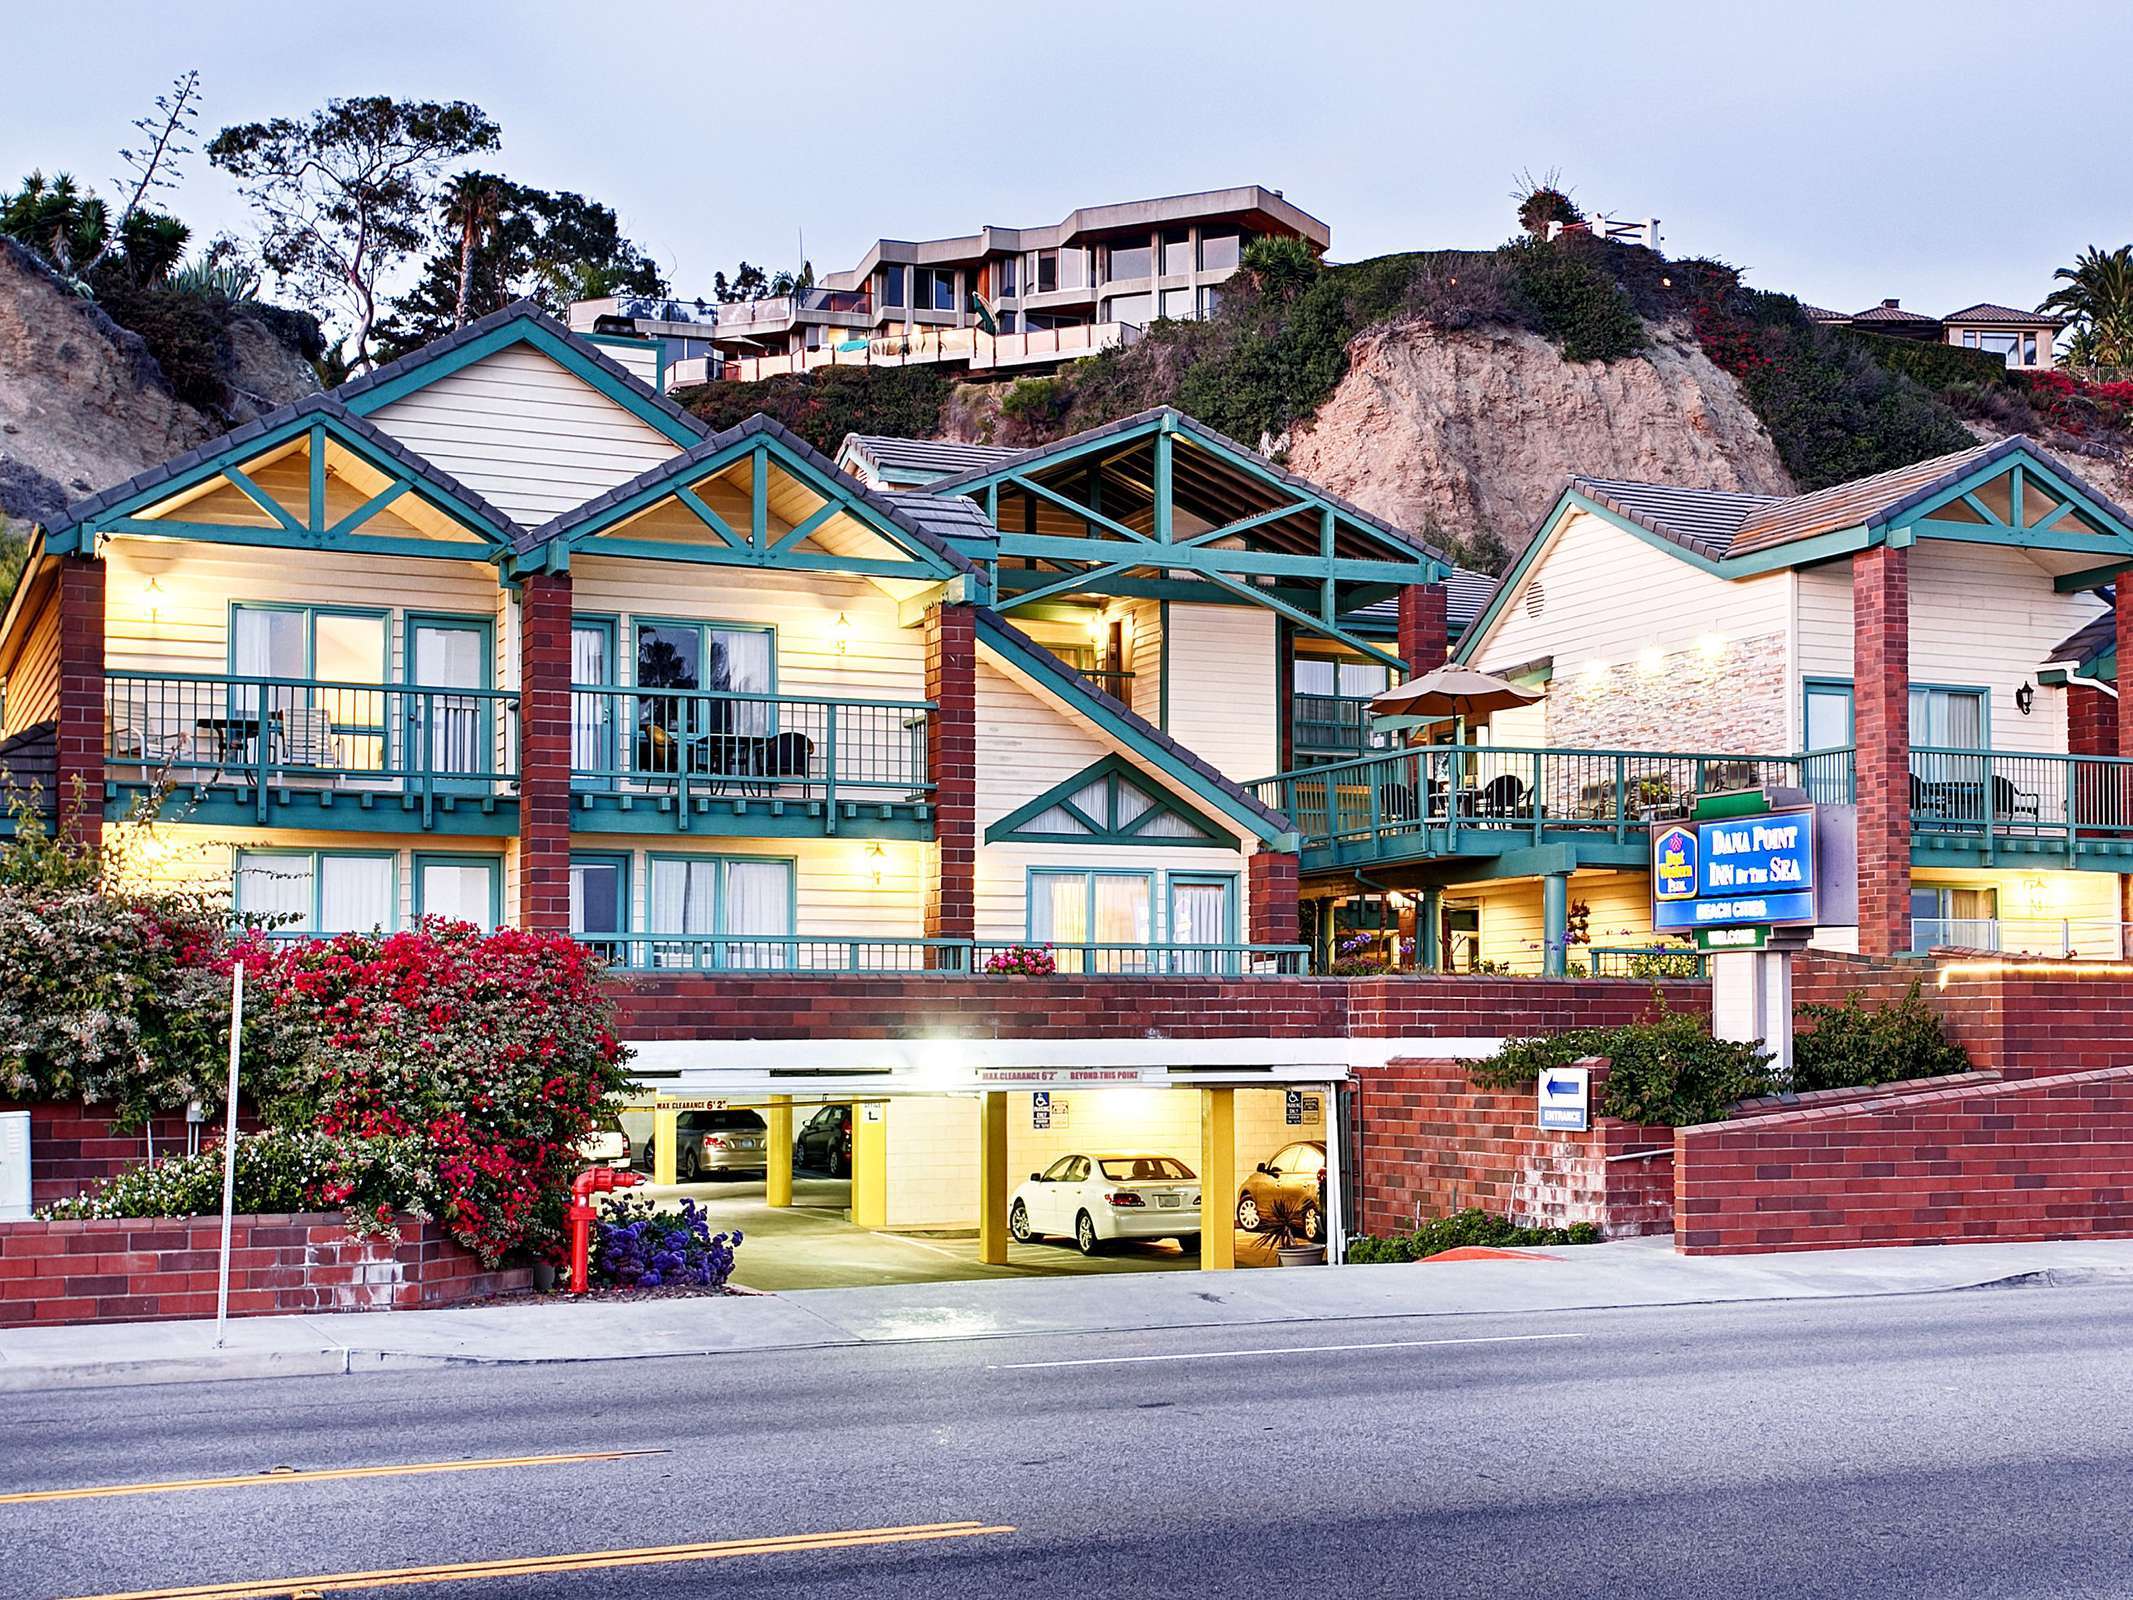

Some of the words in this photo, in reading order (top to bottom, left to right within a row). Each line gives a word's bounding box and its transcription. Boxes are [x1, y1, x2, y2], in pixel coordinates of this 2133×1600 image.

[1709, 862, 1734, 887] INN
[1769, 856, 1802, 882] SEA
[999, 1071, 1041, 1081] CLEARANCE
[1070, 1071, 1098, 1080] BEYOND
[1099, 1071, 1116, 1080] THIS
[1117, 1071, 1138, 1080] POINT
[656, 1102, 670, 1110] MAX
[672, 1101, 705, 1110] CLEARANCE
[1544, 1109, 1582, 1122] ENTRANCE
